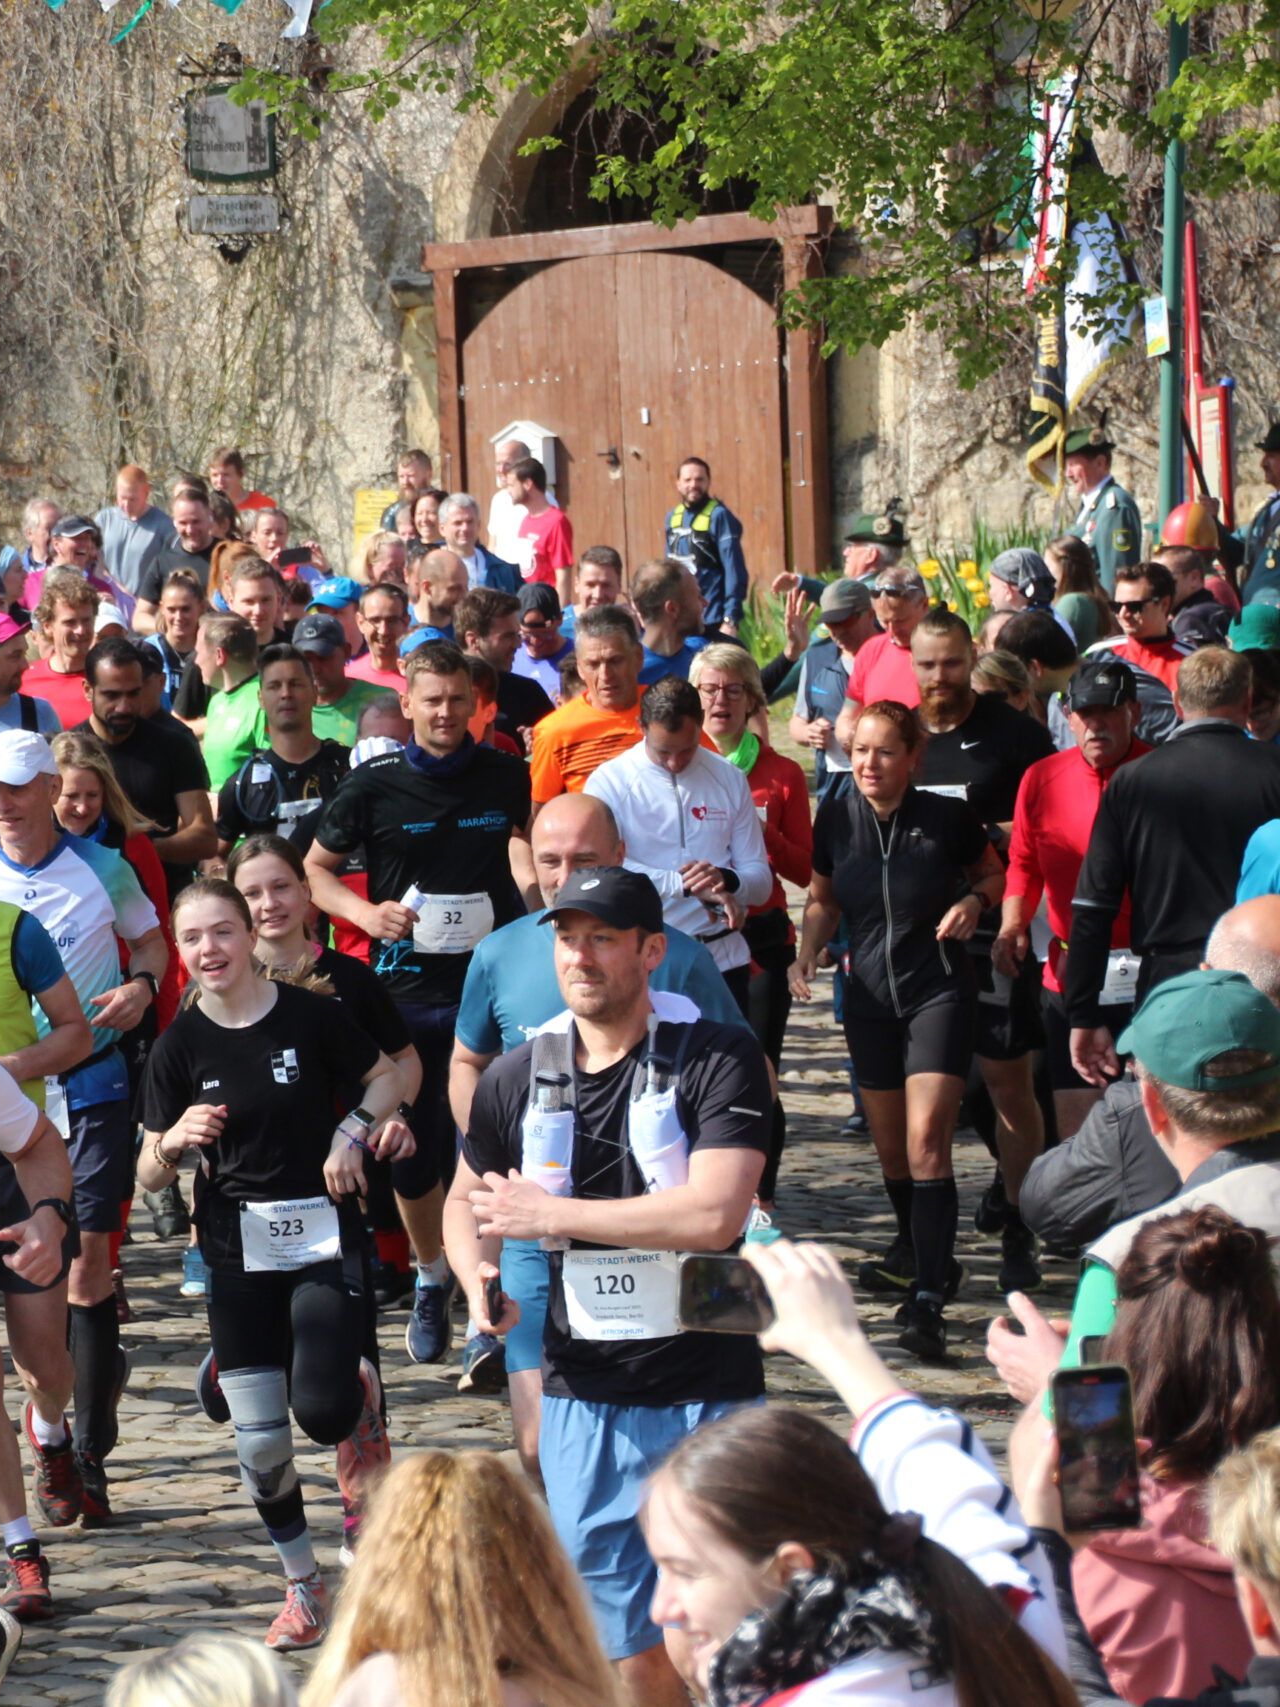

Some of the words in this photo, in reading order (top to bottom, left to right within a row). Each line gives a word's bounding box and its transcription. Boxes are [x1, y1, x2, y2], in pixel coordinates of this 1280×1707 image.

[443, 911, 463, 925] 32
[202, 1080, 220, 1090] Lara
[269, 1219, 305, 1238] 523
[593, 1274, 636, 1295] 120
